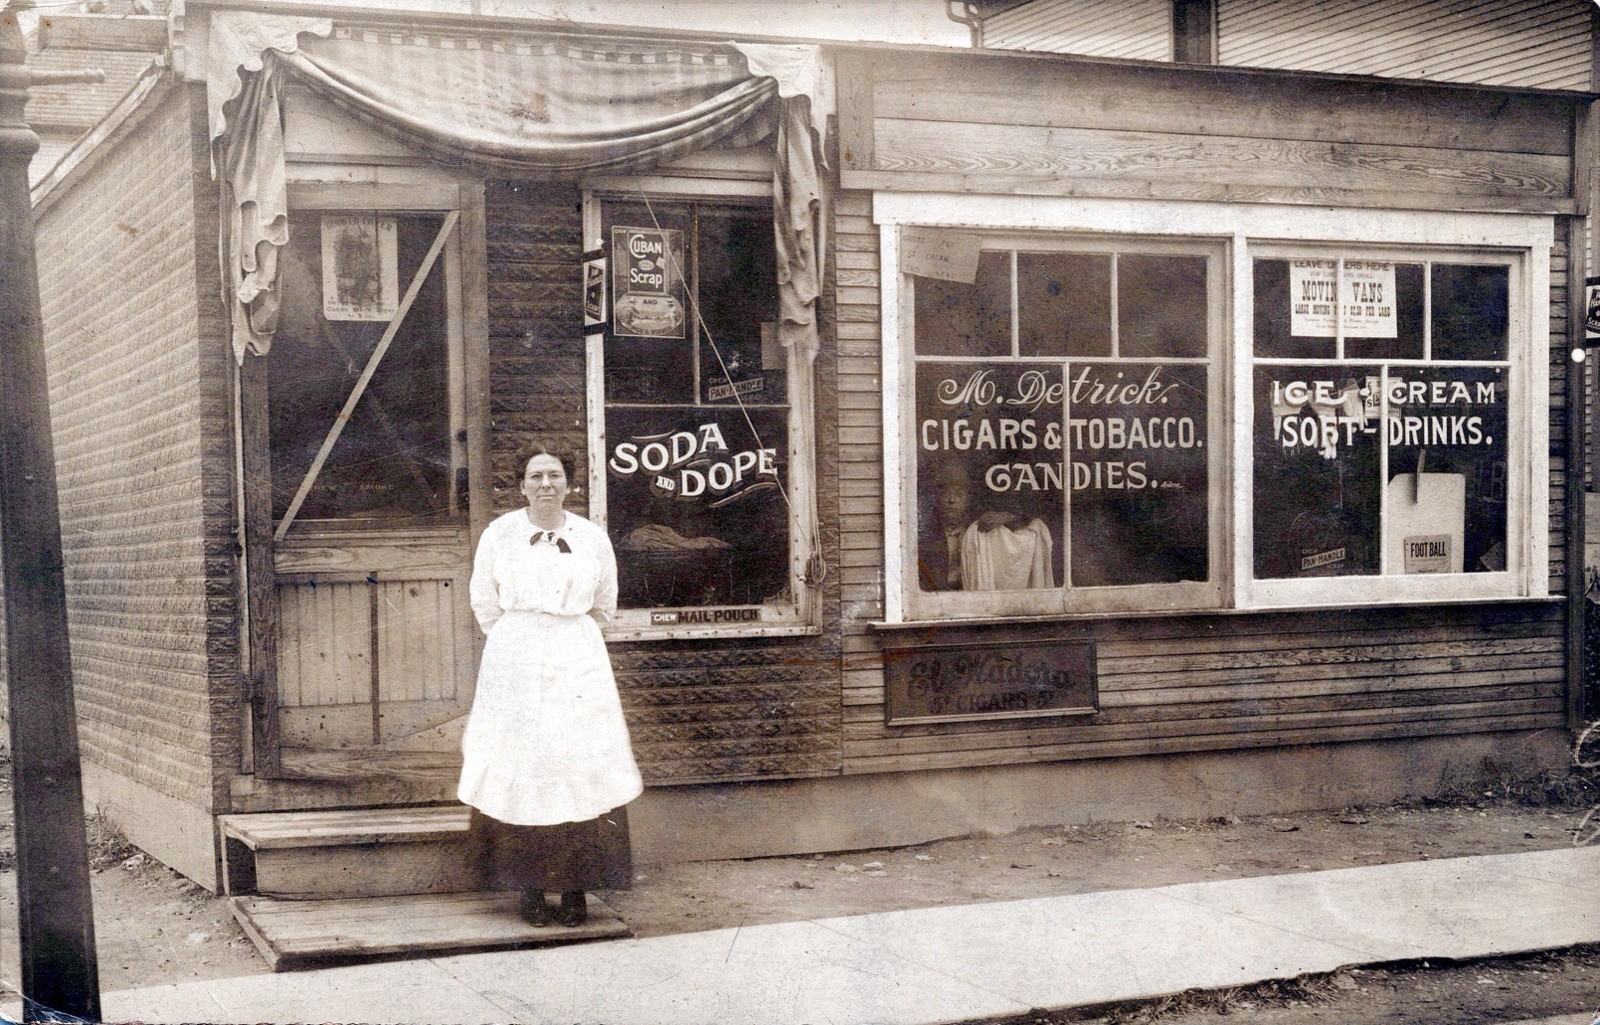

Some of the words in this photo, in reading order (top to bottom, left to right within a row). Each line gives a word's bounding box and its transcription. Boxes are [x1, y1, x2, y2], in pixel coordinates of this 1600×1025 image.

[630, 234, 662, 258] CUBAN
[630, 268, 662, 288] Scrap
[1294, 260, 1323, 269] LEAVE
[1327, 261, 1362, 270] ORERS
[1366, 262, 1390, 271] HERE
[1302, 280, 1337, 302] MOVIN
[1352, 282, 1383, 303] VANS
[937, 369, 1003, 406] M.
[1273, 381, 1348, 405] ICE
[1388, 381, 1496, 405] CREAM
[922, 418, 1037, 450] CIGARS
[1043, 421, 1062, 450] &
[1069, 417, 1203, 449] TOBACCO.
[1388, 416, 1493, 446] DRINKS.
[609, 423, 729, 474] SODA
[655, 475, 675, 491] AND
[680, 448, 778, 497] DOPE
[985, 461, 1158, 492] CANDIES.
[653, 613, 677, 622] CHEW
[678, 611, 710, 623] MAIL
[714, 609, 758, 622] POUCH
